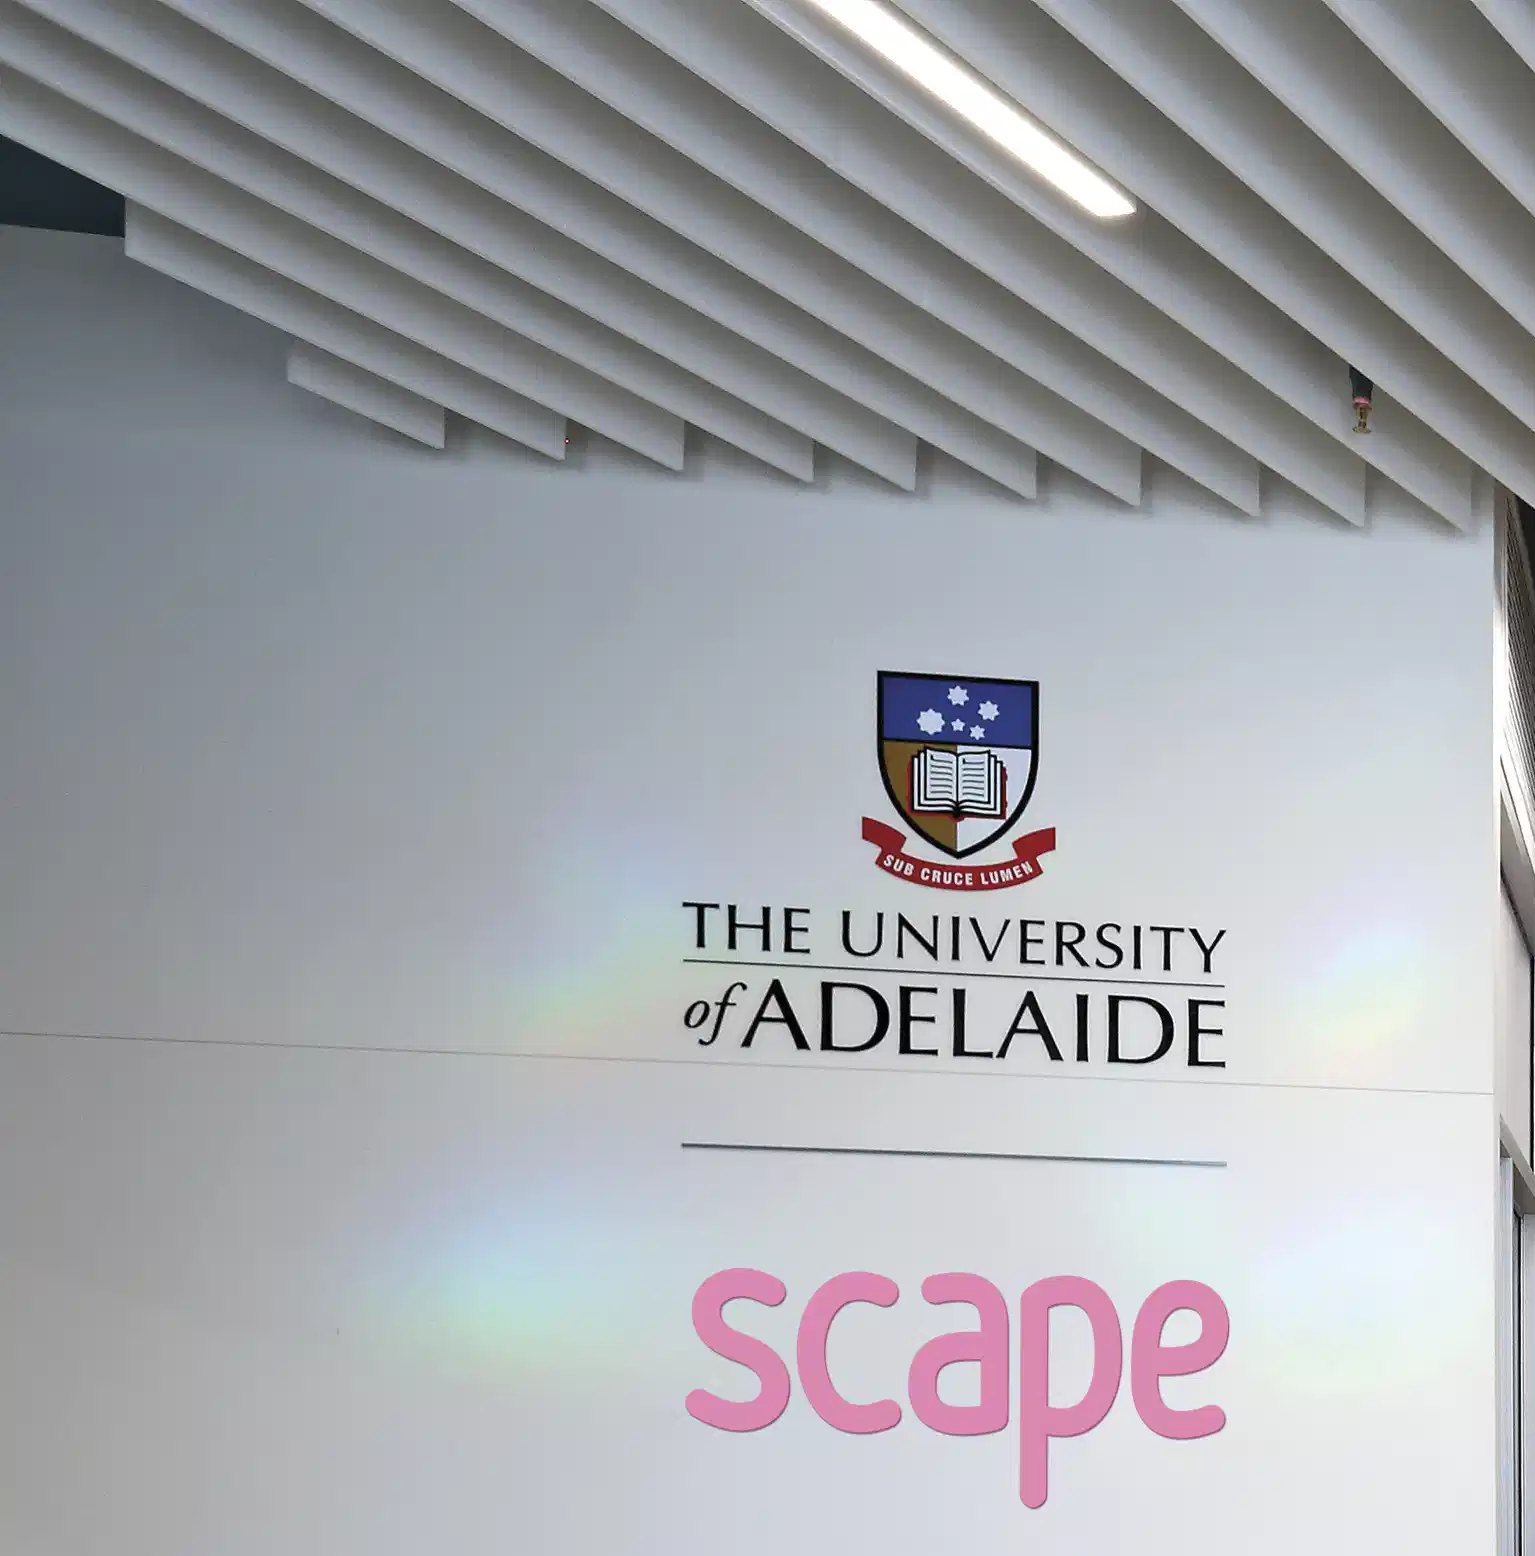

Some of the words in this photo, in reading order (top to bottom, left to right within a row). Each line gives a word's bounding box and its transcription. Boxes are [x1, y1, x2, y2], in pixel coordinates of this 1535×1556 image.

[883, 854, 914, 877] SUB
[920, 867, 973, 886] CRUCE
[980, 860, 1034, 886] LUMEN
[682, 901, 811, 954] THE
[841, 910, 1227, 973] UNIVERSITY
[683, 982, 748, 1046] of
[740, 978, 1226, 1068] ADELAIDE
[685, 1267, 1230, 1510] scape
